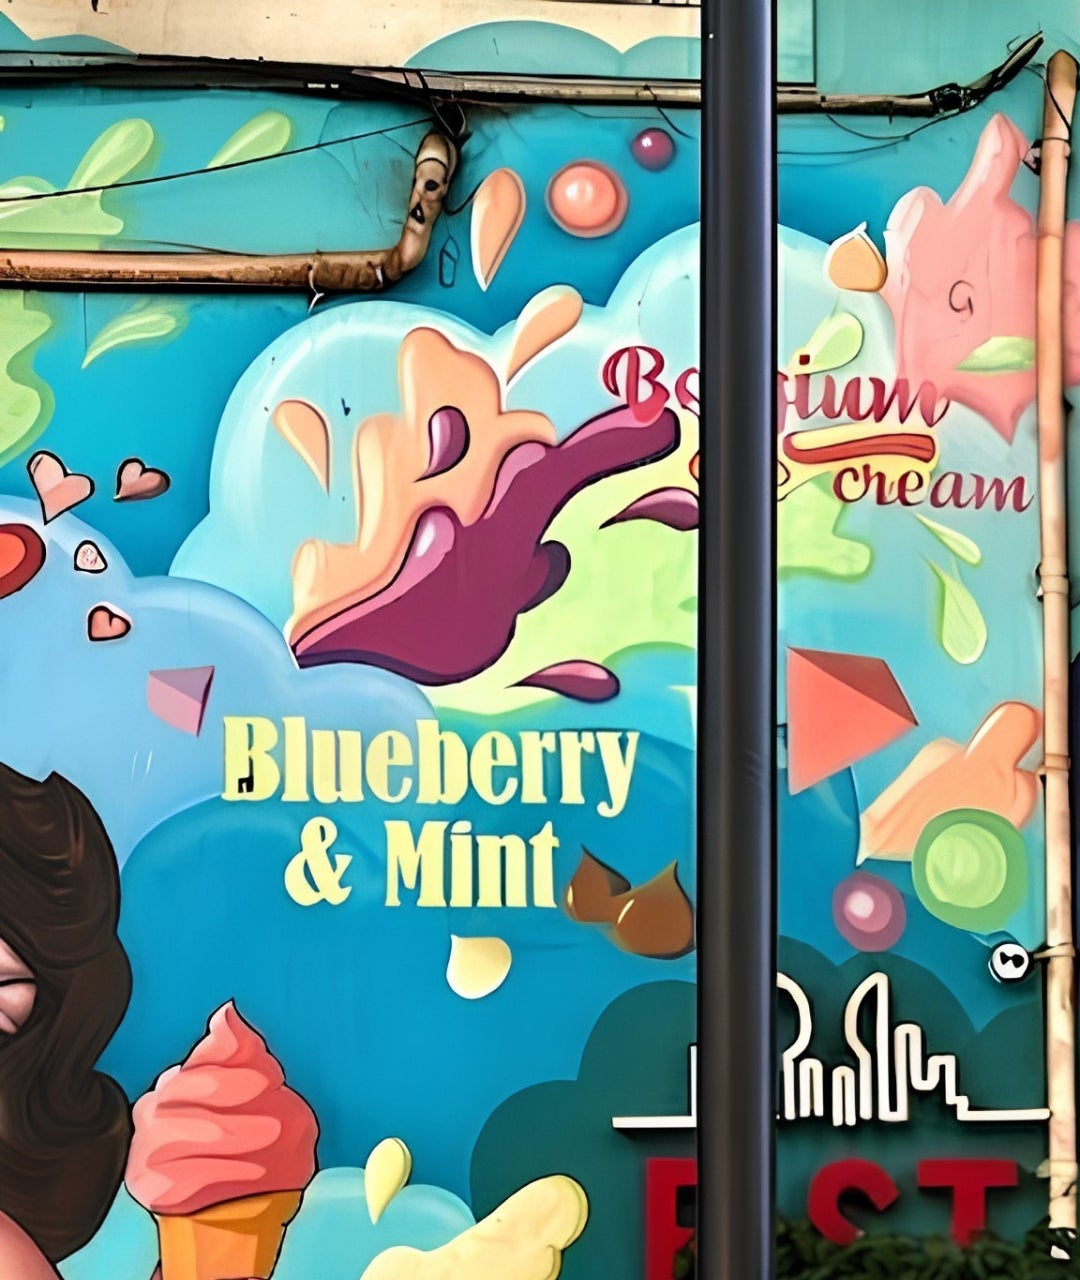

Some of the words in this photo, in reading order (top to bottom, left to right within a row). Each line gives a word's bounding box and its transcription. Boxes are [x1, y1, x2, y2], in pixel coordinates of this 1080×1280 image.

[602, 345, 951, 436] Beium
[833, 463, 1034, 512] cream
[221, 716, 640, 818] Blueberry
[284, 816, 353, 905] &
[384, 820, 560, 908] Mint
